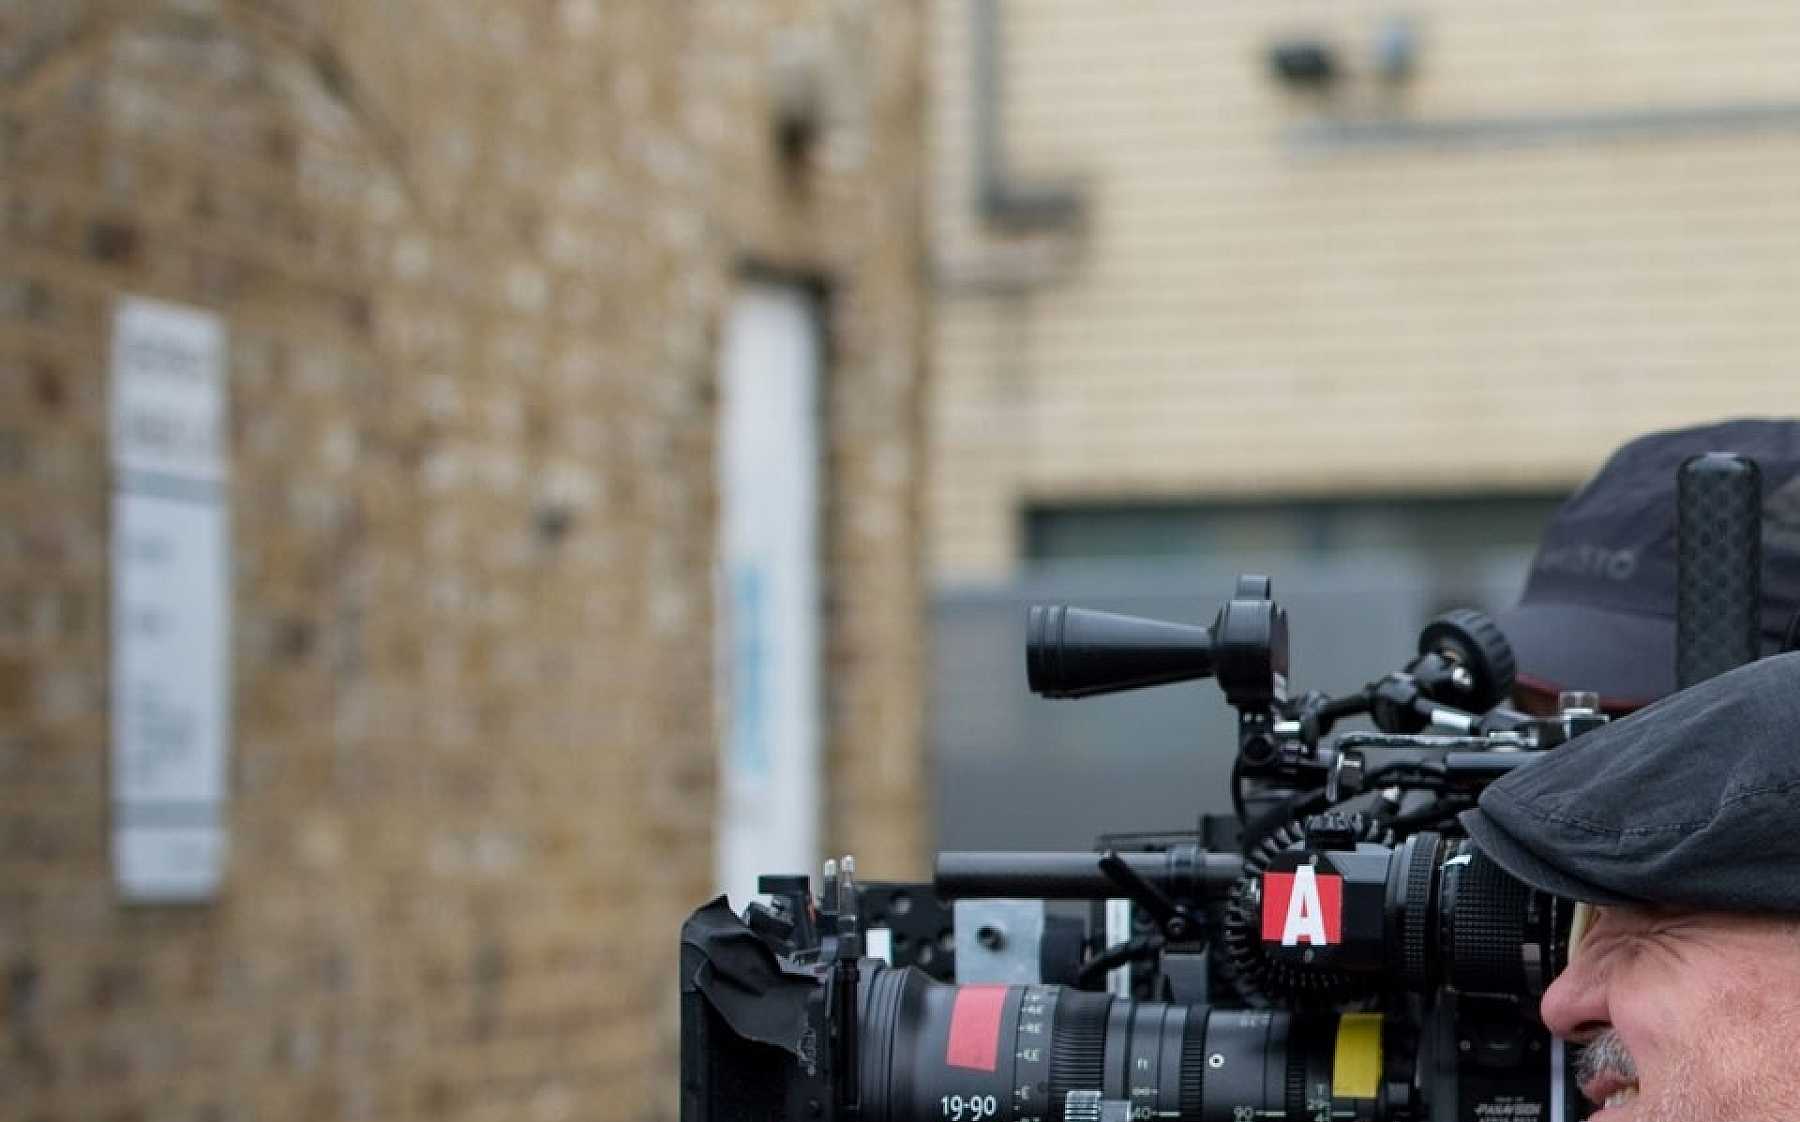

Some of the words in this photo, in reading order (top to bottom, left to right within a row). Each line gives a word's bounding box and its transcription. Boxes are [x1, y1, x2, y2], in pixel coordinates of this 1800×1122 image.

[1282, 864, 1327, 946] A
[940, 1094, 997, 1121] 19-90
[1233, 1105, 1254, 1119] 90
